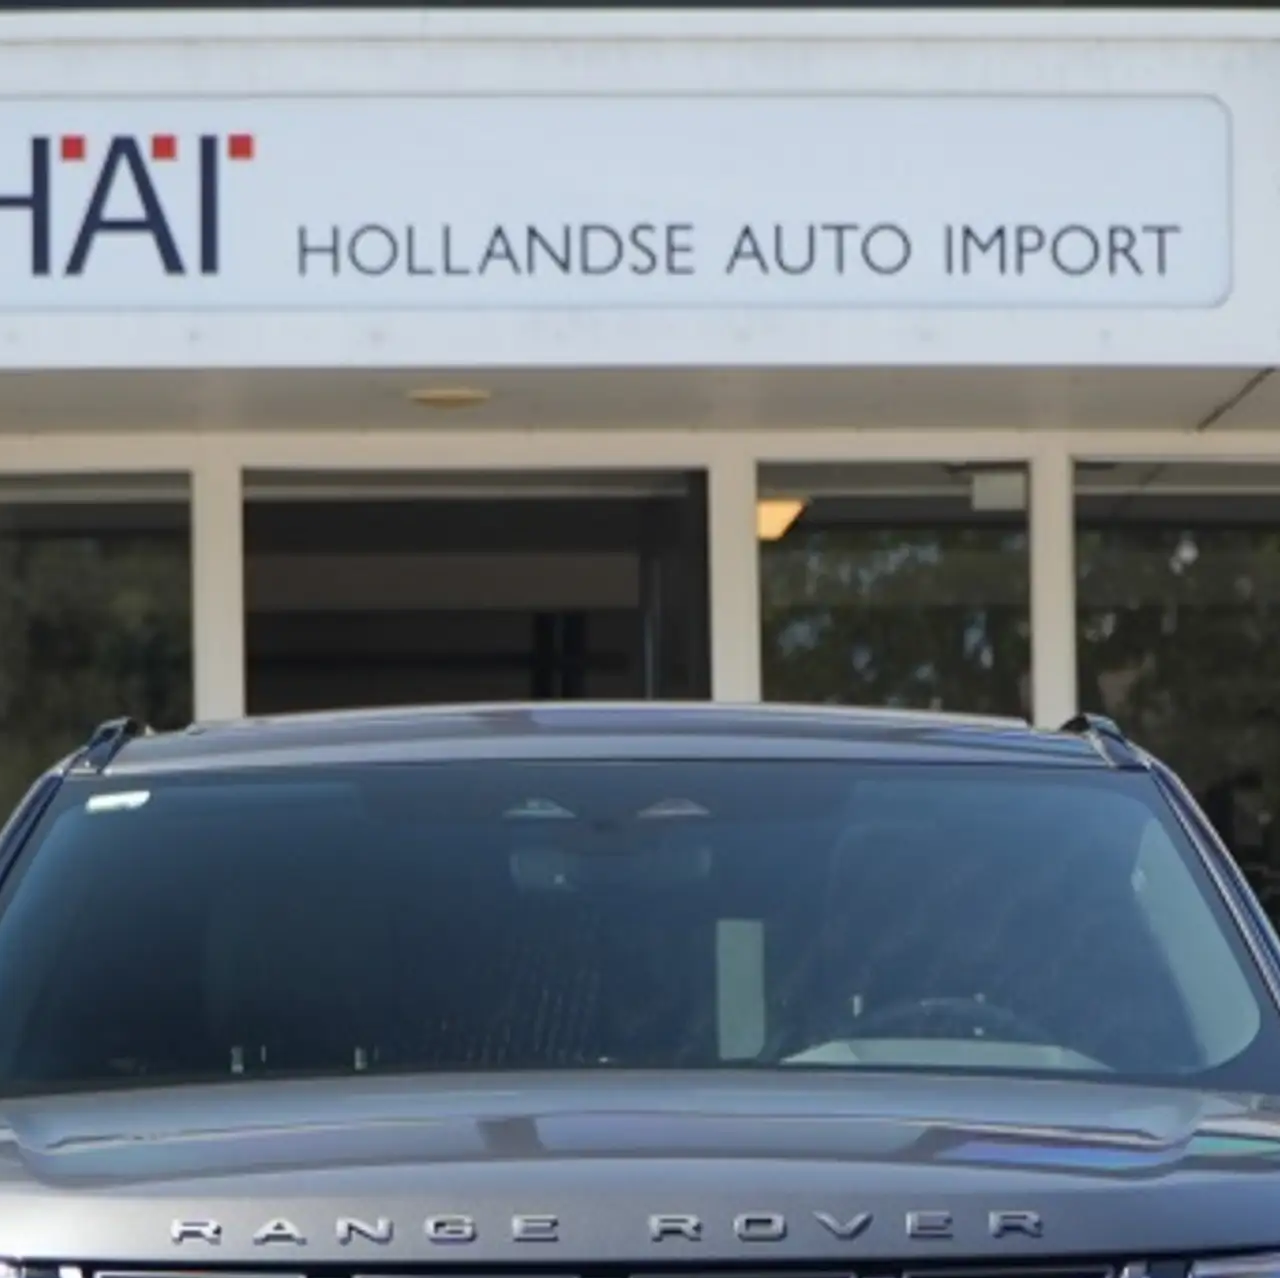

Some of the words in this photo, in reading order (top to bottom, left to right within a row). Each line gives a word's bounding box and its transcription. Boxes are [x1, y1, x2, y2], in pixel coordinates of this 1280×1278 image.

[297, 223, 696, 277] HOLLANDSE
[725, 223, 912, 276] AUTO
[943, 223, 1183, 277] IMPORT
[170, 1213, 561, 1247] RANGE
[647, 1209, 1044, 1243] ROVER
